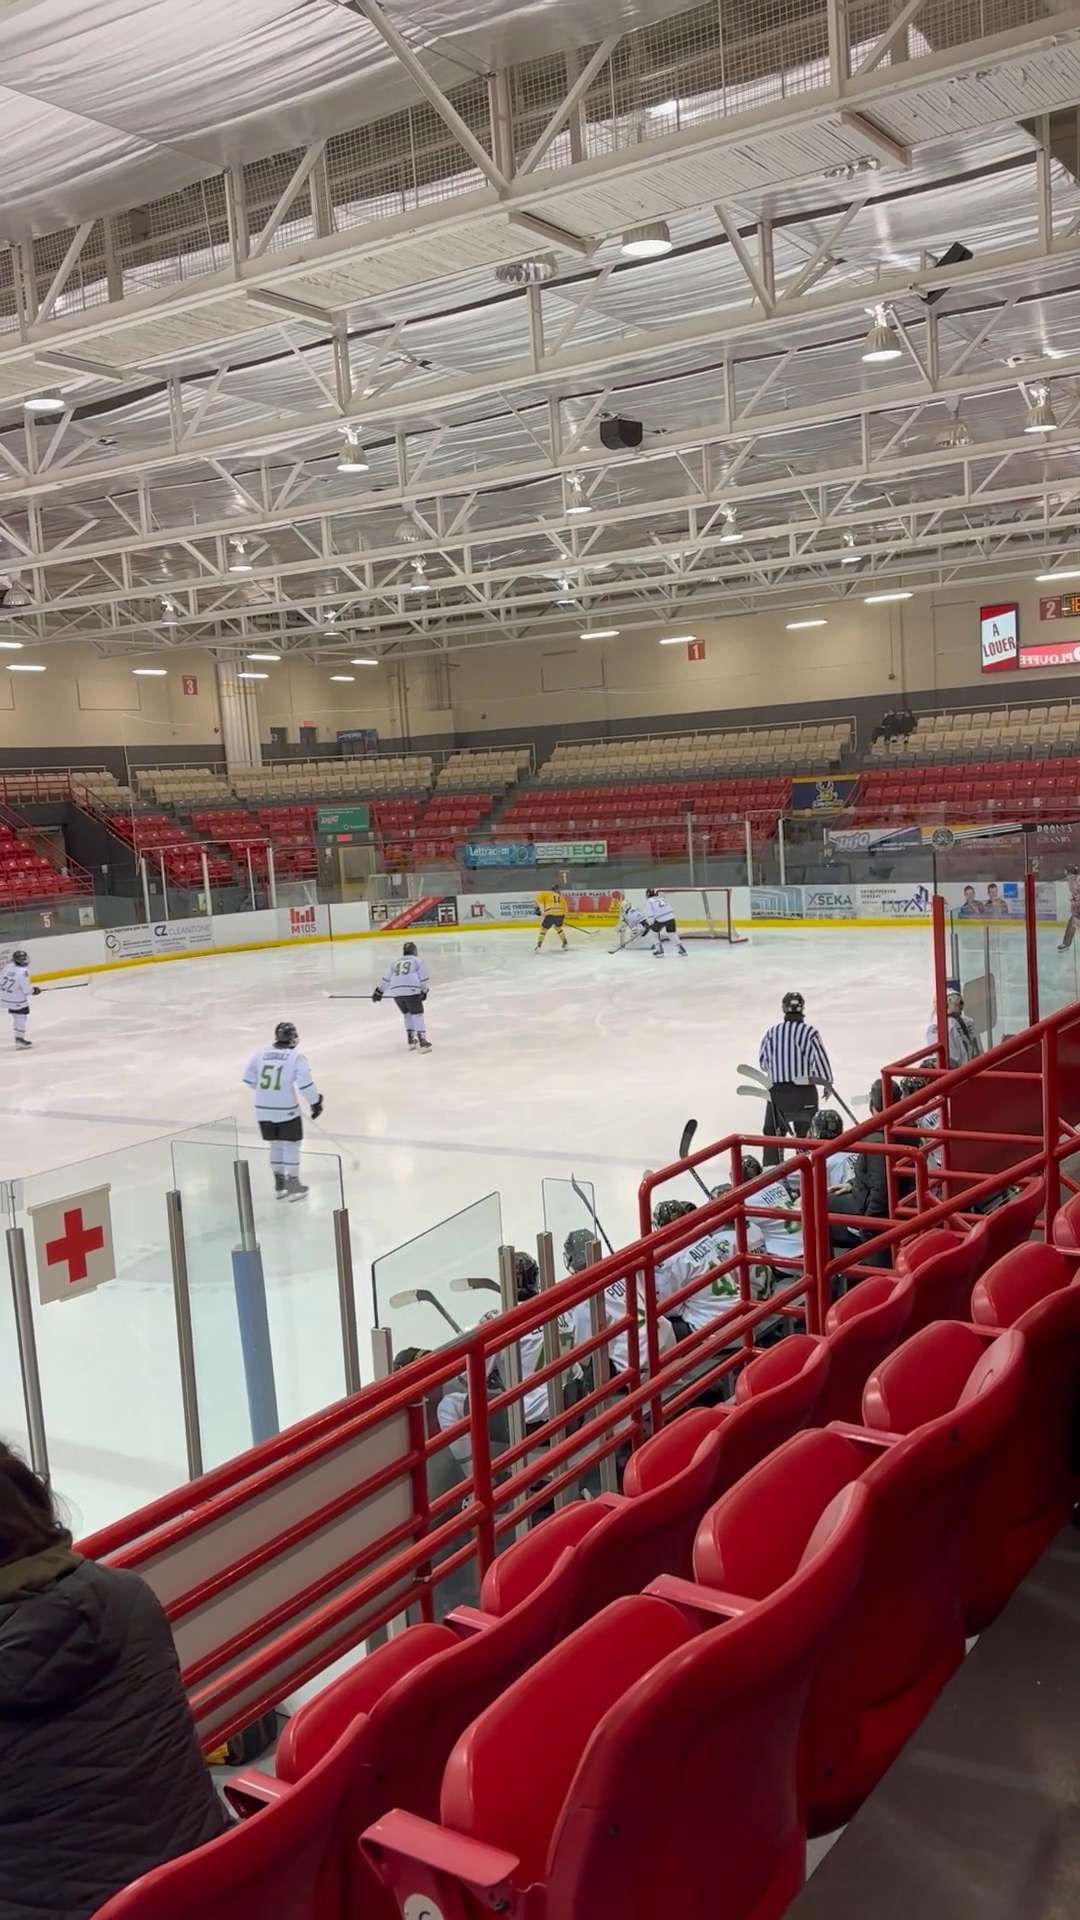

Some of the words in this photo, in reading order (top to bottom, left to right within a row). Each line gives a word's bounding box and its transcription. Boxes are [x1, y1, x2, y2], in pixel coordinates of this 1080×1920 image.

[1046, 601, 1056, 619] 2
[992, 621, 1000, 637] À
[692, 644, 699, 660] 1
[983, 636, 1016, 657] LOUER
[186, 679, 194, 695] 3
[1032, 859, 1040, 873] 2
[562, 872, 568, 884] 1
[43, 915, 51, 928] 5
[168, 923, 211, 936] CLEANZONE
[291, 923, 317, 935] M105
[394, 961, 411, 976] 49
[1, 976, 15, 993] 22
[260, 1064, 283, 1091] 51
